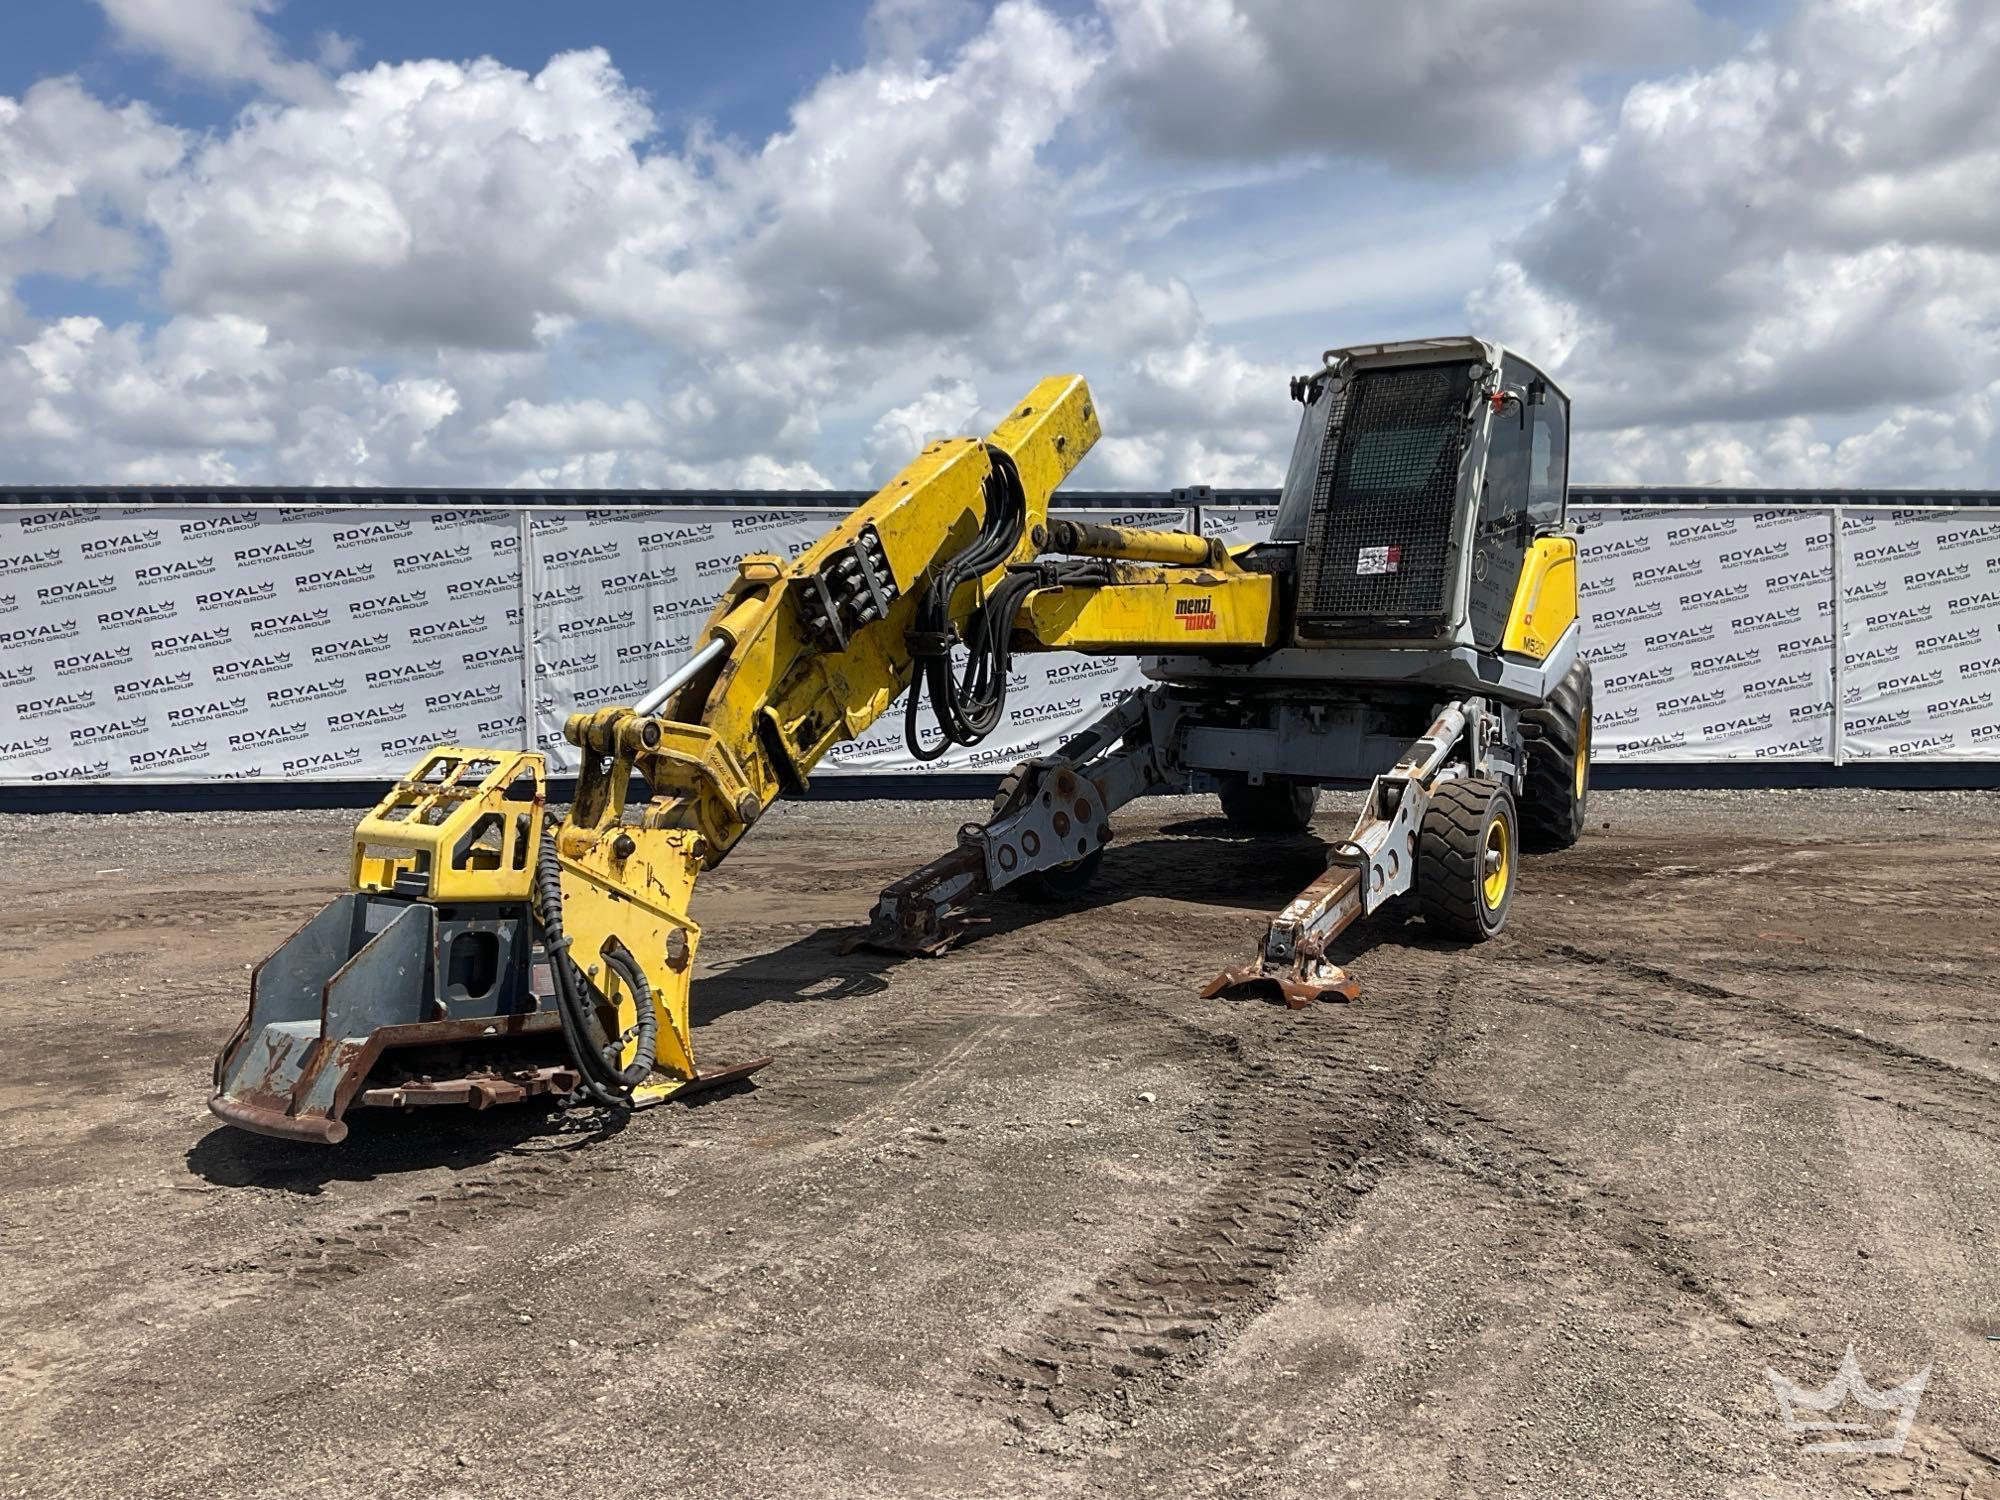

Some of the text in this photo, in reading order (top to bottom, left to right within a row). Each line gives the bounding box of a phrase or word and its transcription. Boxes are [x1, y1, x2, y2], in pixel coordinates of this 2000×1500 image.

[334, 525, 395, 542] ROYAL
[337, 530, 413, 548] AUCTION GROUP
[638, 529, 697, 545] ROYAL
[1667, 524, 1721, 539] ROYAL
[1670, 529, 1737, 545] AUCTION GROUP
[81, 534, 143, 553] ROYAL
[84, 541, 161, 560] AUCTION GROUP
[642, 535, 715, 551] AUCTION GROUP
[1580, 540, 1635, 557] ROYAL
[394, 550, 454, 567] ROYAL
[543, 546, 603, 564] ROYAL
[546, 552, 620, 570] AUCTION GROUP
[1583, 546, 1651, 563] AUCTION GROUP
[1720, 546, 1773, 563] ROYAL
[1722, 552, 1789, 569] AUCTION GROUP
[1854, 544, 1906, 561] ROYAL
[1856, 550, 1921, 567] AUCTION GROUP
[135, 561, 197, 579] ROYAL
[397, 556, 473, 574] AUCTION GROUP
[1633, 563, 1687, 580] ROYAL
[138, 567, 216, 586] AUCTION GROUP
[602, 571, 661, 588] ROYAL
[1635, 569, 1703, 587] AUCTION GROUP
[1904, 567, 1955, 584] ROYAL
[1906, 573, 1971, 590] AUCTION GROUP
[196, 586, 258, 604] ROYAL
[605, 577, 678, 595] AUCTION GROUP
[199, 593, 277, 611] AUCTION GROUP
[1176, 595, 1211, 614] menzi
[1680, 588, 1734, 605] ROYAL
[1682, 594, 1750, 611] AUCTION GROUP
[98, 605, 159, 623] ROYAL
[101, 611, 177, 630] AUCTION GROUP
[251, 613, 313, 631] ROYAL
[1592, 605, 1647, 622] ROYAL
[1595, 611, 1663, 629] AUCTION GROUP
[1732, 611, 1786, 628] ROYAL
[1866, 609, 1917, 625] ROYAL
[254, 619, 331, 638] AUCTION GROUP
[410, 619, 470, 637] ROYAL
[559, 615, 618, 633] ROYAL
[562, 621, 636, 639] AUCTION GROUP
[1734, 617, 1802, 634] AUCTION GROUP
[1869, 615, 1933, 632] AUCTION GROUP
[152, 631, 214, 650] ROYAL
[413, 626, 488, 644] AUCTION GROUP
[1916, 632, 1967, 649] ROYAL
[155, 638, 232, 657] AUCTION GROUP
[312, 638, 373, 656] ROYAL
[315, 644, 391, 662] AUCTION GROUP
[617, 639, 675, 657] ROYAL
[619, 645, 692, 663] AUCTION GROUP
[1918, 638, 1982, 655] AUCTION GROUP
[54, 651, 115, 669] ROYAL
[57, 657, 133, 676] AUCTION GROUP
[213, 656, 275, 675] ROYAL
[216, 663, 293, 682] AUCTION GROUP
[366, 664, 426, 682] ROYAL
[1047, 662, 1102, 677] ROYAL
[1049, 667, 1119, 683] AUCTION GROUP
[369, 670, 445, 689] AUCTION GROUP
[1604, 671, 1658, 688] ROYAL
[1606, 676, 1675, 694] AUCTION GROUP
[1743, 676, 1797, 693] ROYAL
[1878, 673, 1929, 690] ROYAL
[1880, 679, 1944, 697] AUCTION GROUP
[426, 688, 485, 706] ROYAL
[574, 683, 633, 701] ROYAL
[576, 689, 650, 707] AUCTION GROUP
[1745, 682, 1813, 699] AUCTION GROUP
[17, 695, 78, 713] ROYAL
[20, 701, 96, 720] AUCTION GROUP
[428, 694, 503, 713] AUCTION GROUP
[1657, 693, 1711, 710] ROYAL
[1659, 699, 1727, 717] AUCTION GROUP
[1927, 696, 1978, 713] ROYAL
[1929, 702, 1993, 719] AUCTION GROUP
[328, 707, 389, 725] ROYAL
[1011, 702, 1066, 720] ROYAL
[1013, 708, 1083, 726] AUCTION GROUP
[71, 721, 131, 740] ROYAL
[331, 713, 407, 732] AUCTION GROUP
[1703, 717, 1757, 735] ROYAL
[1844, 714, 1896, 730] ROYAL
[1847, 719, 1911, 736] AUCTION GROUP
[73, 727, 149, 746] AUCTION GROUP
[229, 726, 291, 745] ROYAL
[1706, 724, 1773, 741] AUCTION GROUP
[232, 732, 309, 752] AUCTION GROUP
[830, 739, 885, 756] ROYAL
[130, 746, 192, 764] ROYAL
[283, 752, 344, 770] ROYAL
[832, 745, 903, 763] AUCTION GROUP
[969, 744, 1024, 760] ROYAL
[971, 750, 1040, 767] AUCTION GROUP
[133, 752, 210, 771] AUCTION GROUP
[286, 758, 362, 777] AUCTION GROUP
